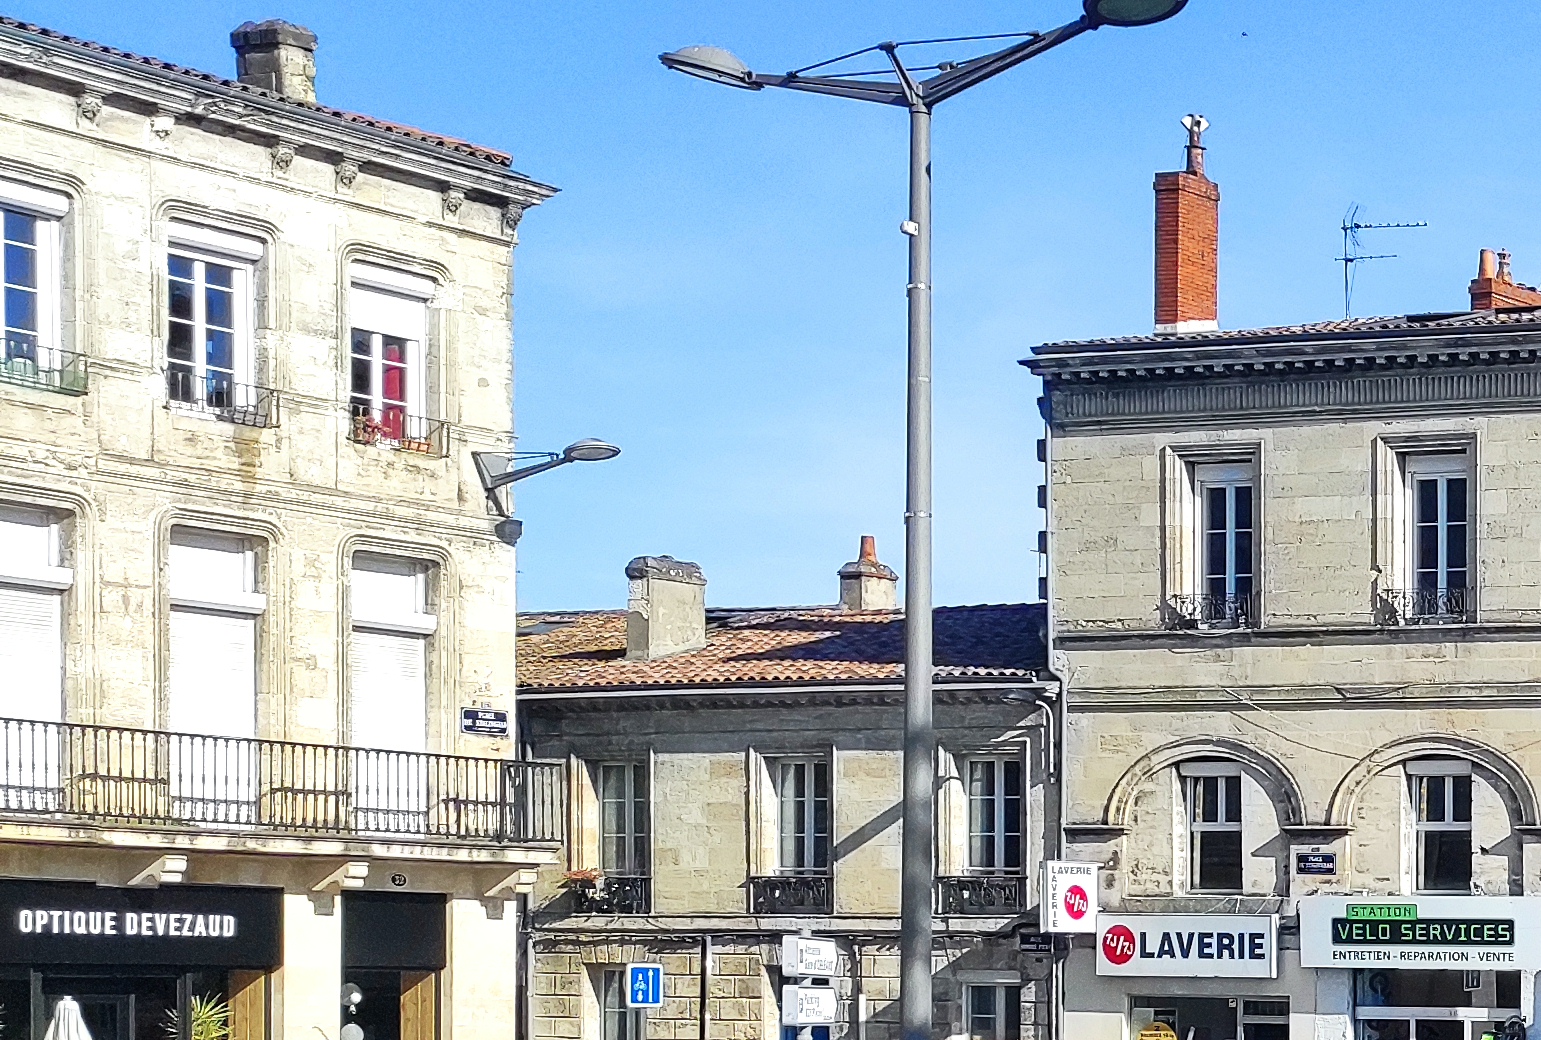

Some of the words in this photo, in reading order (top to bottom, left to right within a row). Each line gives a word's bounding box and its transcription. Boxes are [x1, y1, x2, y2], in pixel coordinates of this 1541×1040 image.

[1051, 865, 1092, 876] LAVERIE
[1351, 906, 1412, 917] STATION
[18, 909, 117, 935] OPTIQUE
[125, 911, 236, 938] DEVEZAUD
[1337, 923, 1391, 941] VELO
[1400, 924, 1510, 942] SERVICES
[1105, 933, 1134, 956] 7J/7J
[1139, 931, 1266, 960] LAVERIE
[1332, 951, 1391, 962] ENTRETIEN
[1400, 951, 1469, 962] REPARATION
[1477, 952, 1515, 963] VENTE
